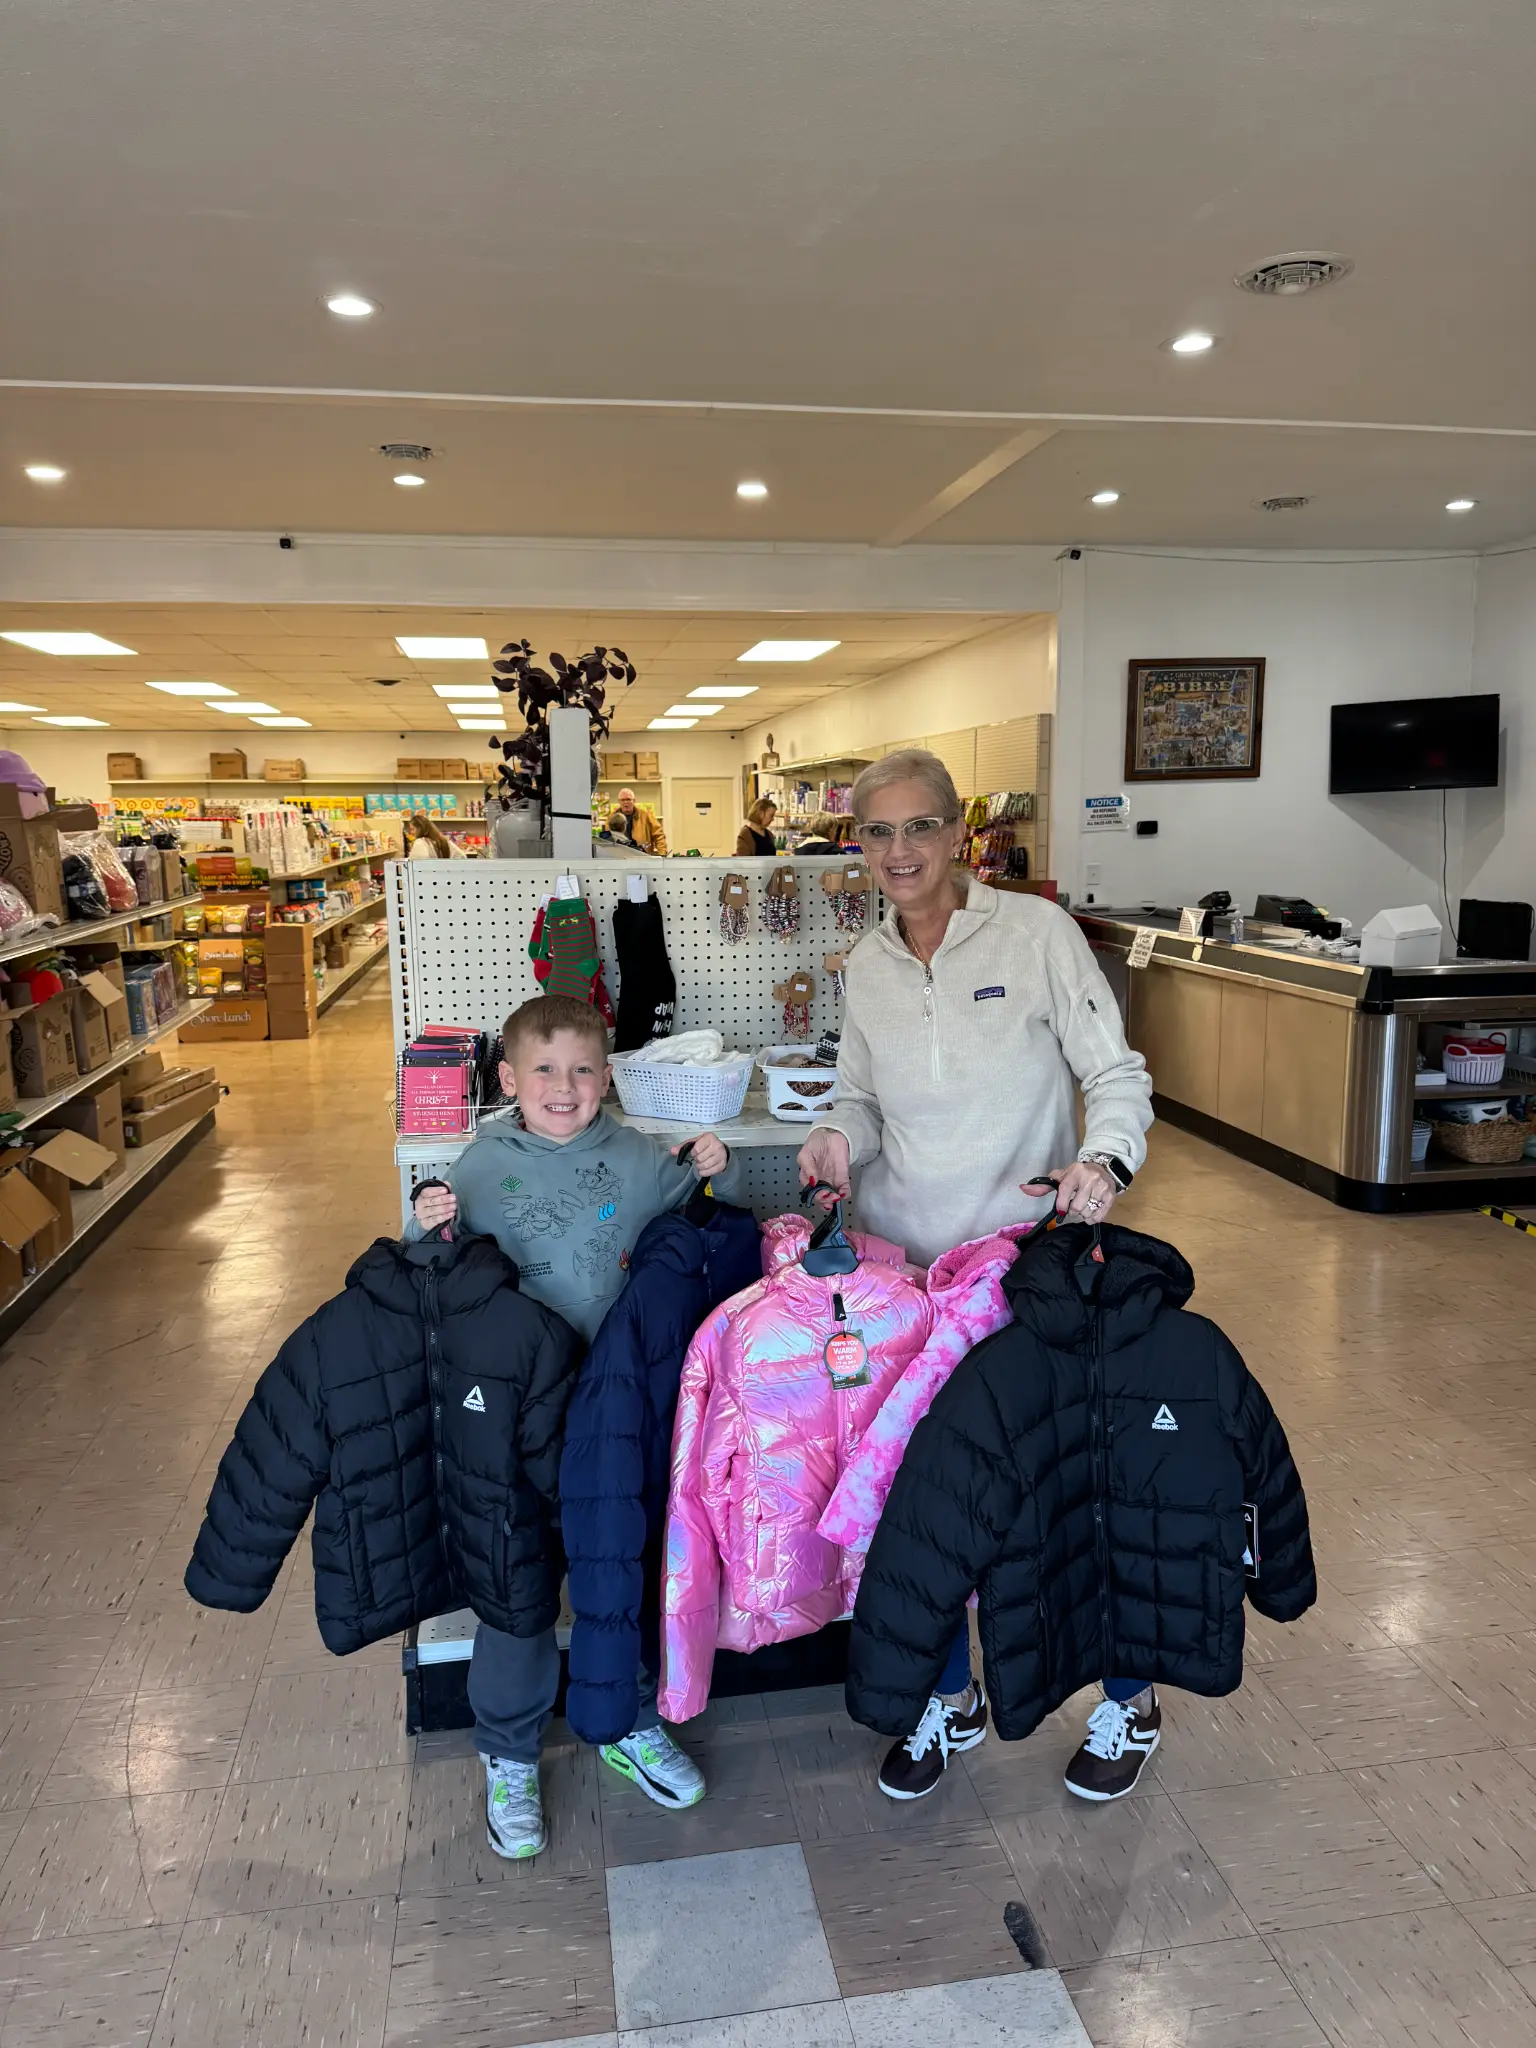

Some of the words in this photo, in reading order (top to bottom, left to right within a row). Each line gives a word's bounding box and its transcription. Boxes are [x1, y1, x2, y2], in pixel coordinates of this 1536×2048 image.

[1162, 680, 1232, 692] BIBLE
[1090, 798, 1119, 807] NOTICE
[977, 990, 1002, 999] patagonia
[223, 1010, 252, 1022] Lunch
[415, 1095, 453, 1104] CHRIST
[520, 1260, 552, 1270] ASTOISE
[520, 1270, 554, 1278] ARIZARD
[833, 1347, 857, 1355] WARM
[462, 1400, 486, 1412] Reebok
[1151, 1422, 1179, 1431] Reebok
